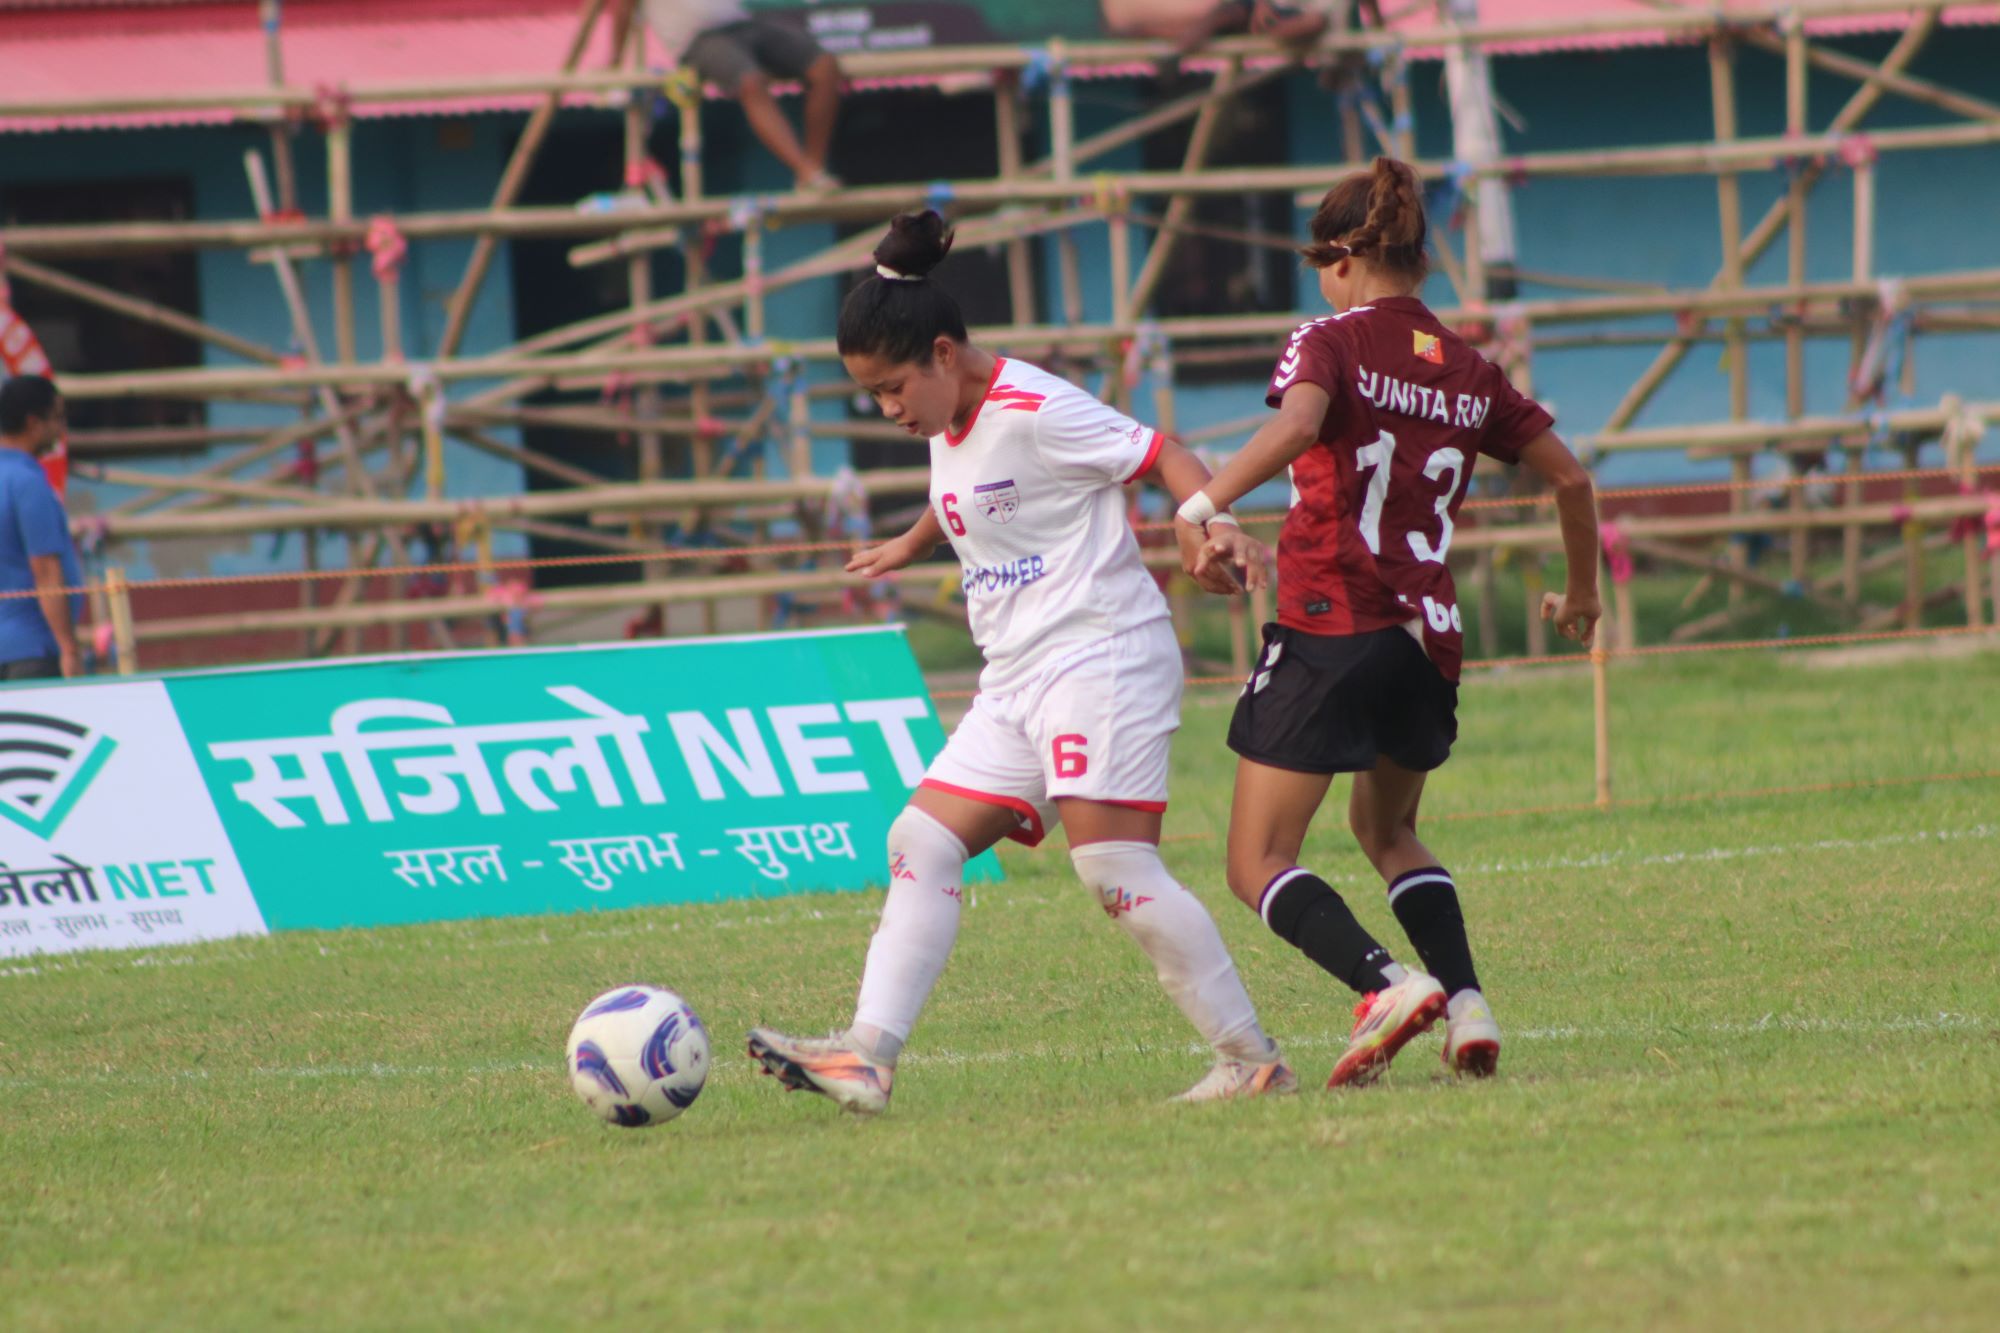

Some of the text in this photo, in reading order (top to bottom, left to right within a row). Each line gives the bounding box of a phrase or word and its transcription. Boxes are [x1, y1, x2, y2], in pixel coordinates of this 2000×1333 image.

[1357, 364, 1449, 424] SUNITA
[941, 493, 967, 537] 6
[1356, 428, 1465, 566] 13
[207, 684, 930, 829] सजिलो NET
[1051, 733, 1088, 778] 6
[102, 858, 216, 901] NET
[382, 844, 508, 888] सरल
[548, 832, 686, 891] सुलभ
[724, 821, 857, 880] सुपथ
